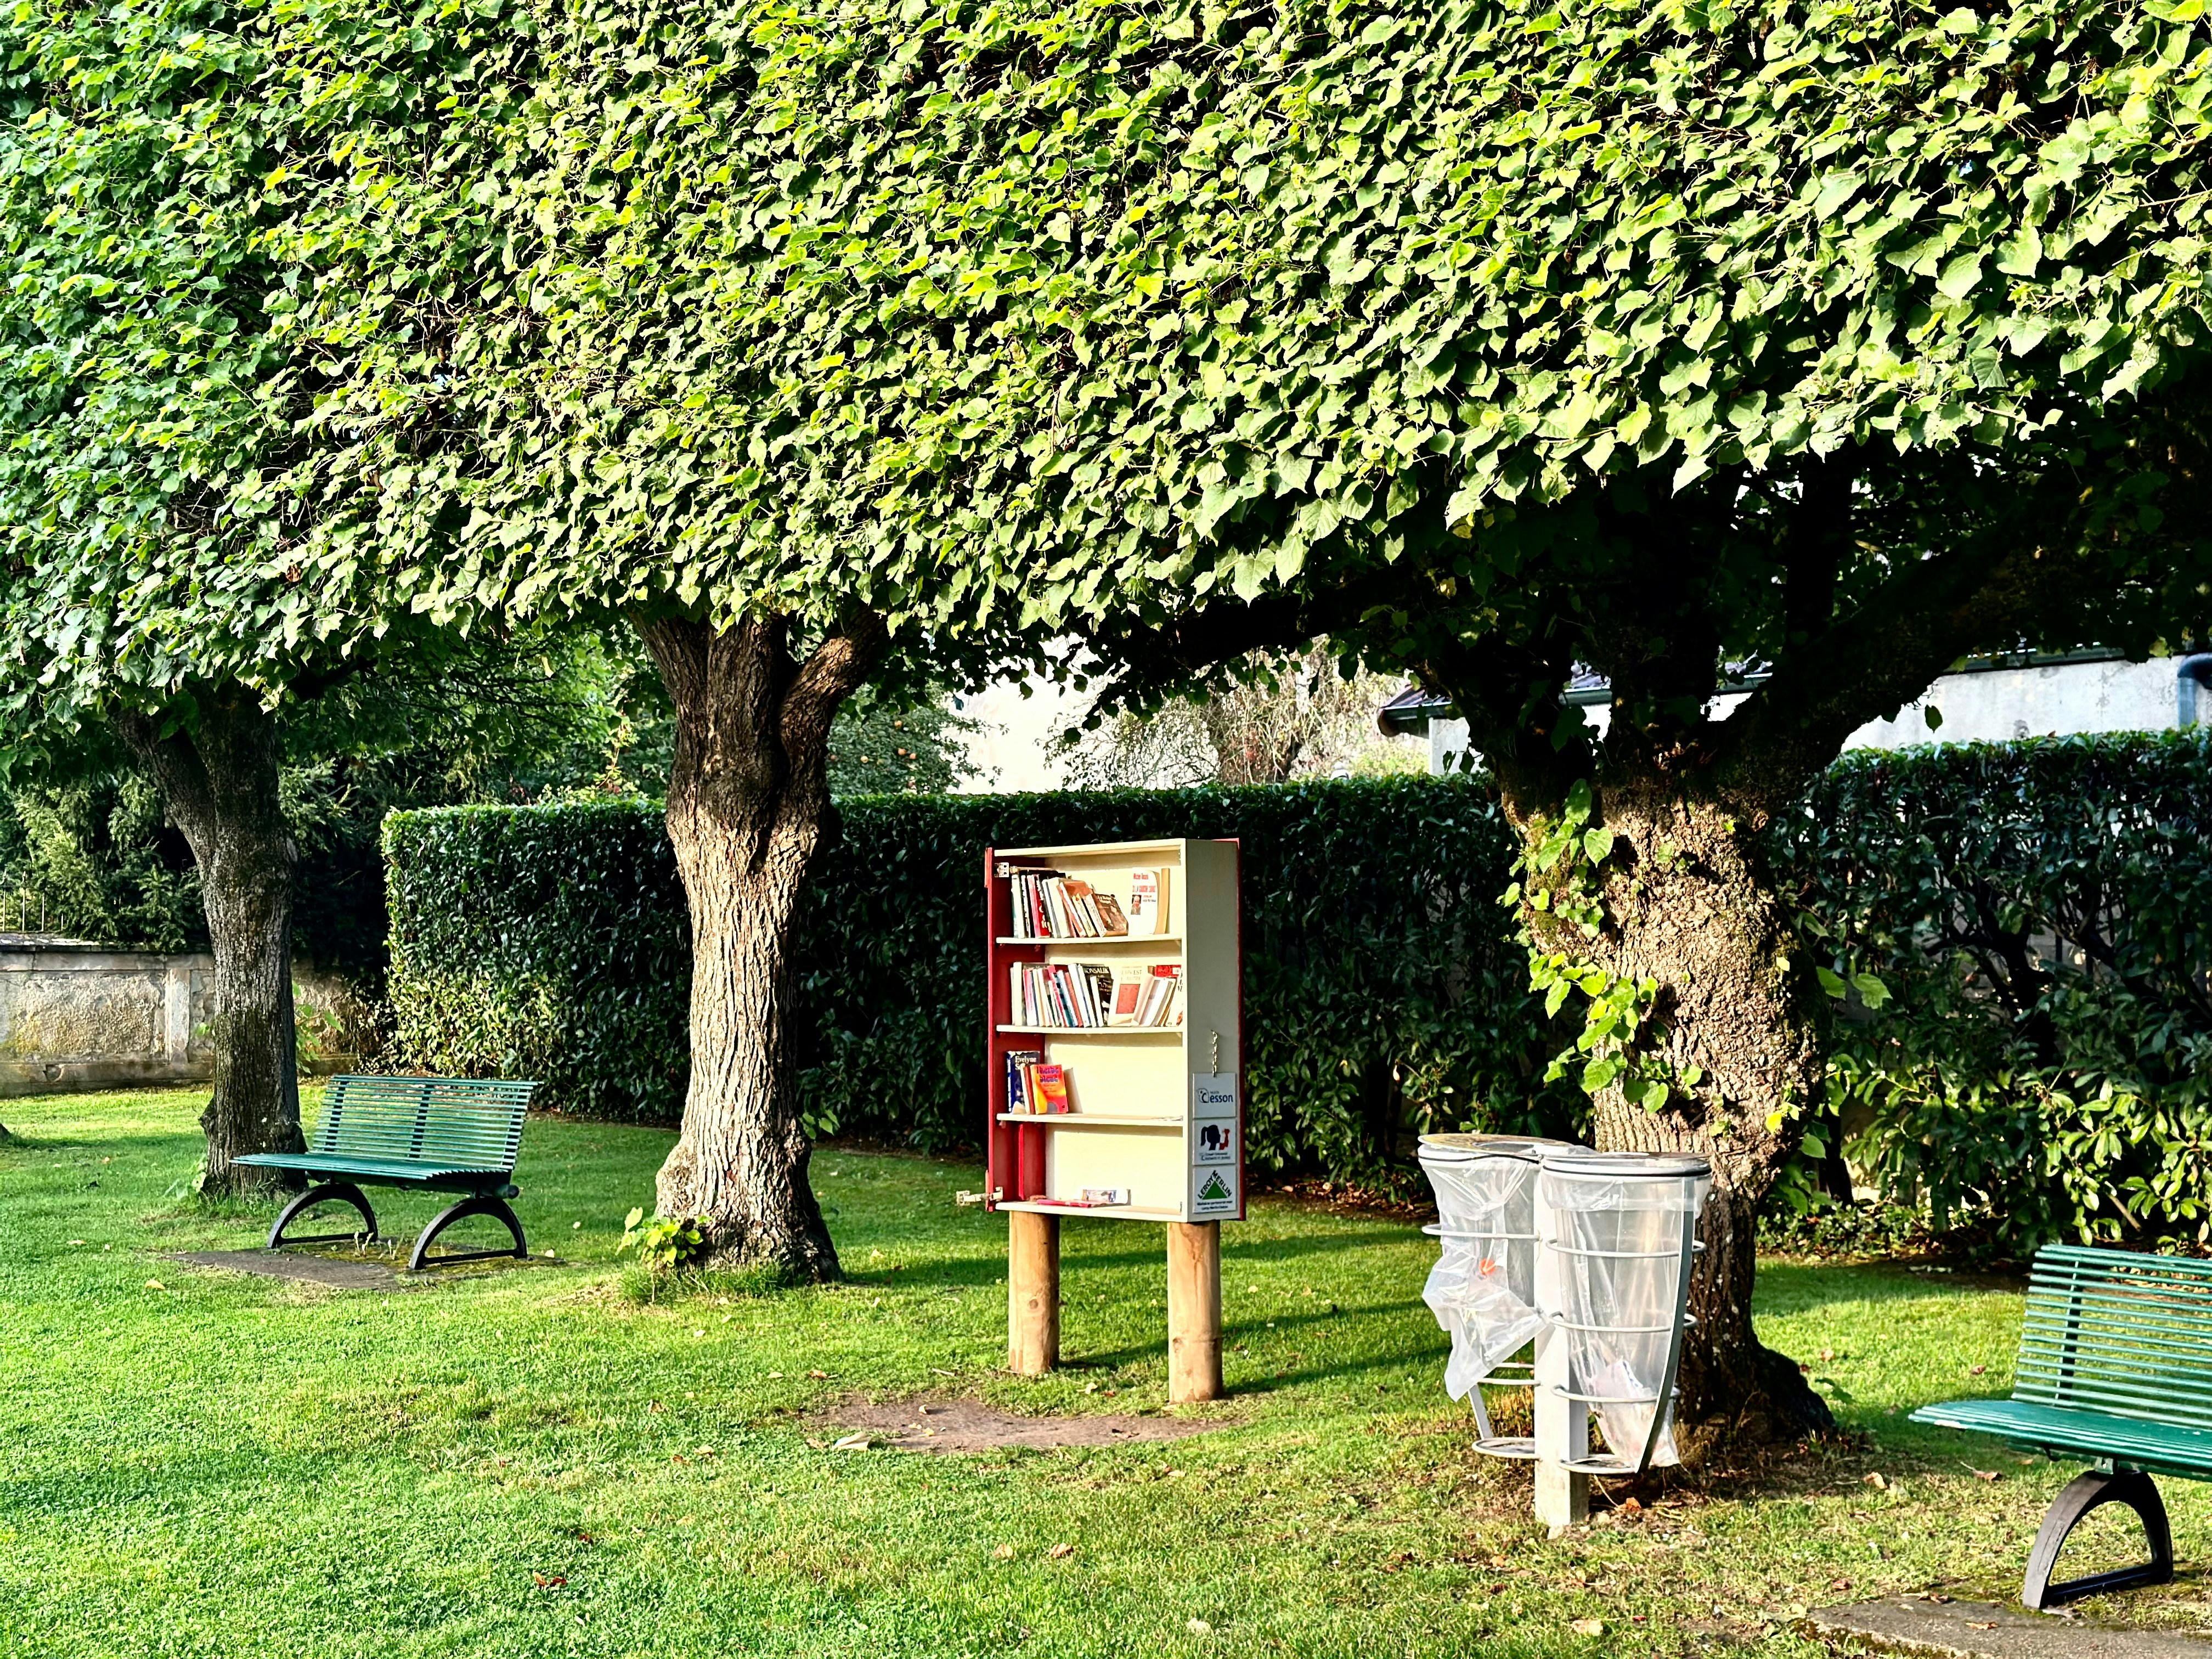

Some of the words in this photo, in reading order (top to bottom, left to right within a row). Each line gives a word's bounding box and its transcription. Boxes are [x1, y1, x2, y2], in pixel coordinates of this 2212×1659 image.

[1015, 1056, 1037, 1064] Evelyne
[1201, 1092, 1234, 1103] Cesson
[1198, 1175, 1214, 1199] LEROY
[1212, 1170, 1232, 1197] MERLIN
